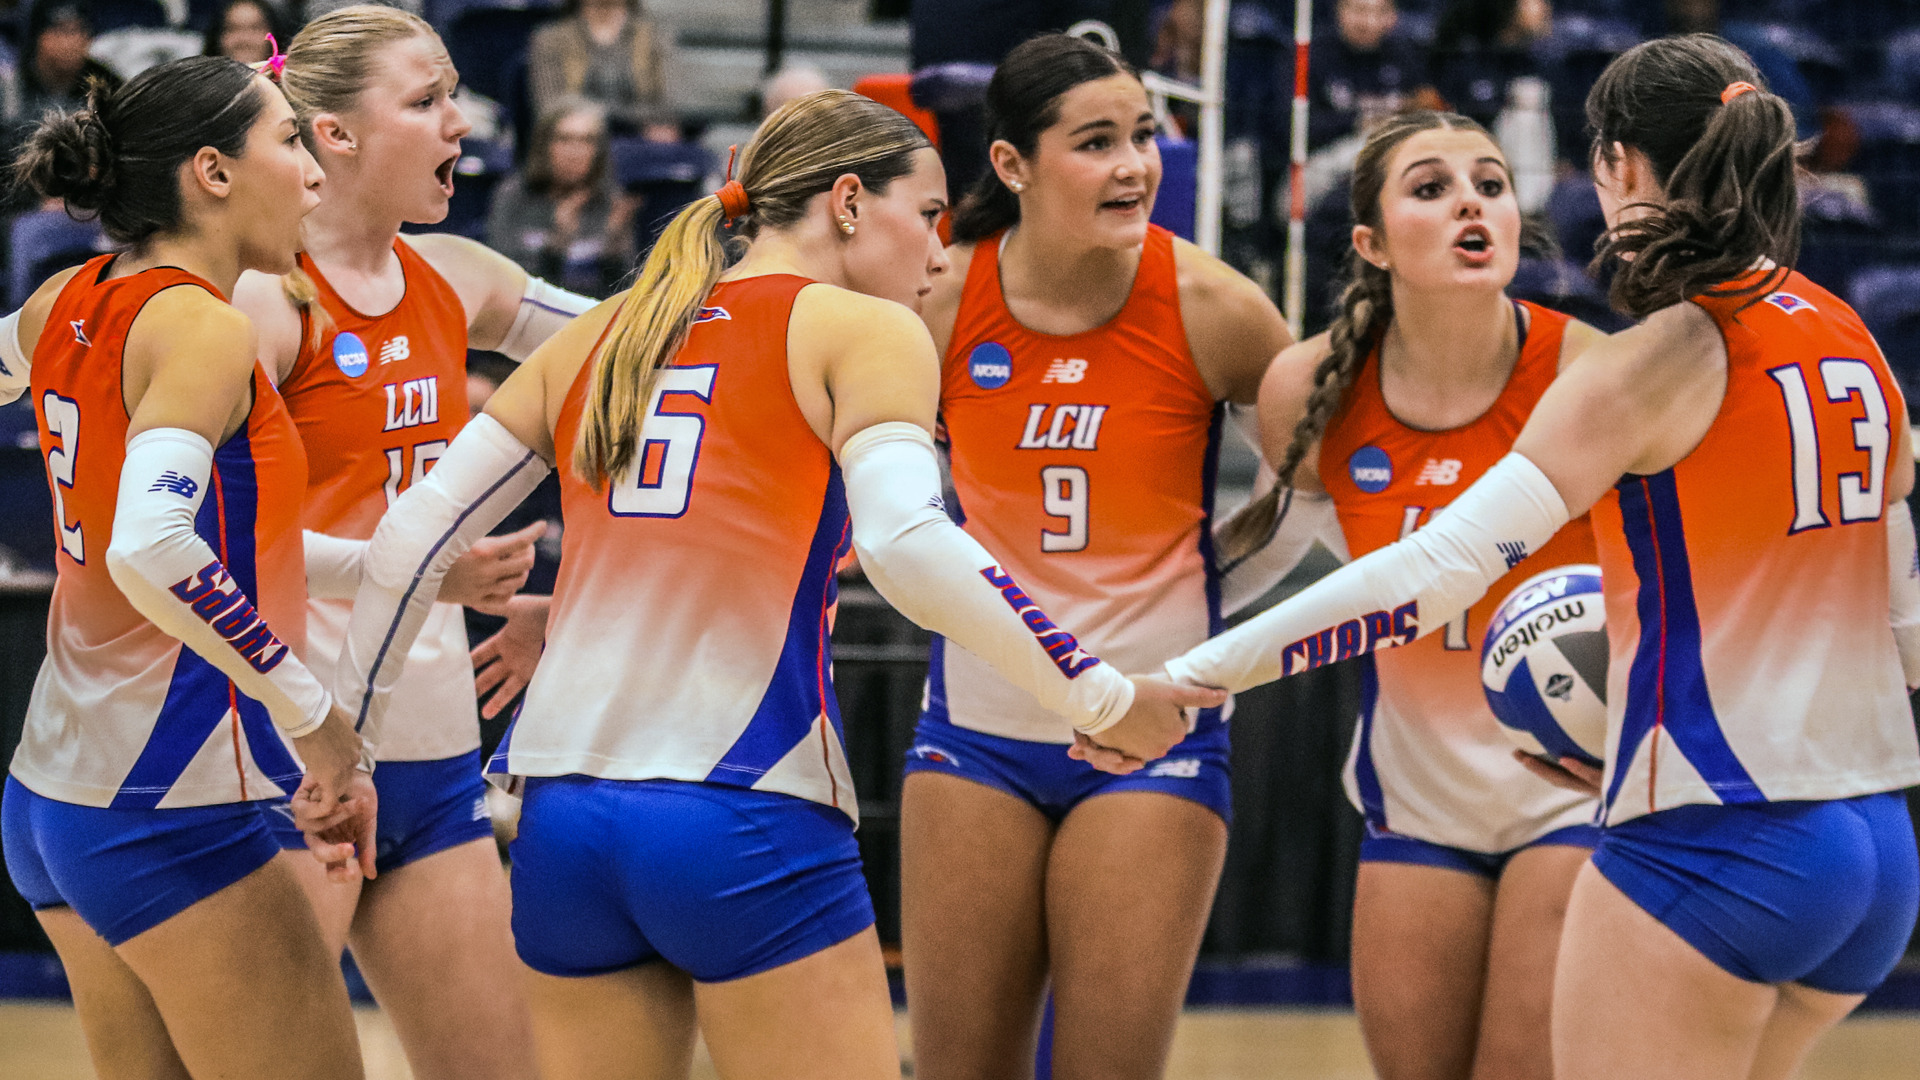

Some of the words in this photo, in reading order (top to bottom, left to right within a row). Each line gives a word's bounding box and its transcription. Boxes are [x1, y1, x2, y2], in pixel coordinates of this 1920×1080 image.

[338, 352, 368, 368] NCAA
[382, 376, 439, 433] LCU
[607, 363, 720, 519] 6
[1014, 403, 1110, 451] LCU
[43, 389, 86, 566] 2
[1766, 357, 1891, 536] 13
[1040, 465, 1090, 553] 9
[168, 559, 290, 675] CHAPS
[1281, 599, 1420, 678] CHAPS
[1492, 600, 1586, 668] molten
